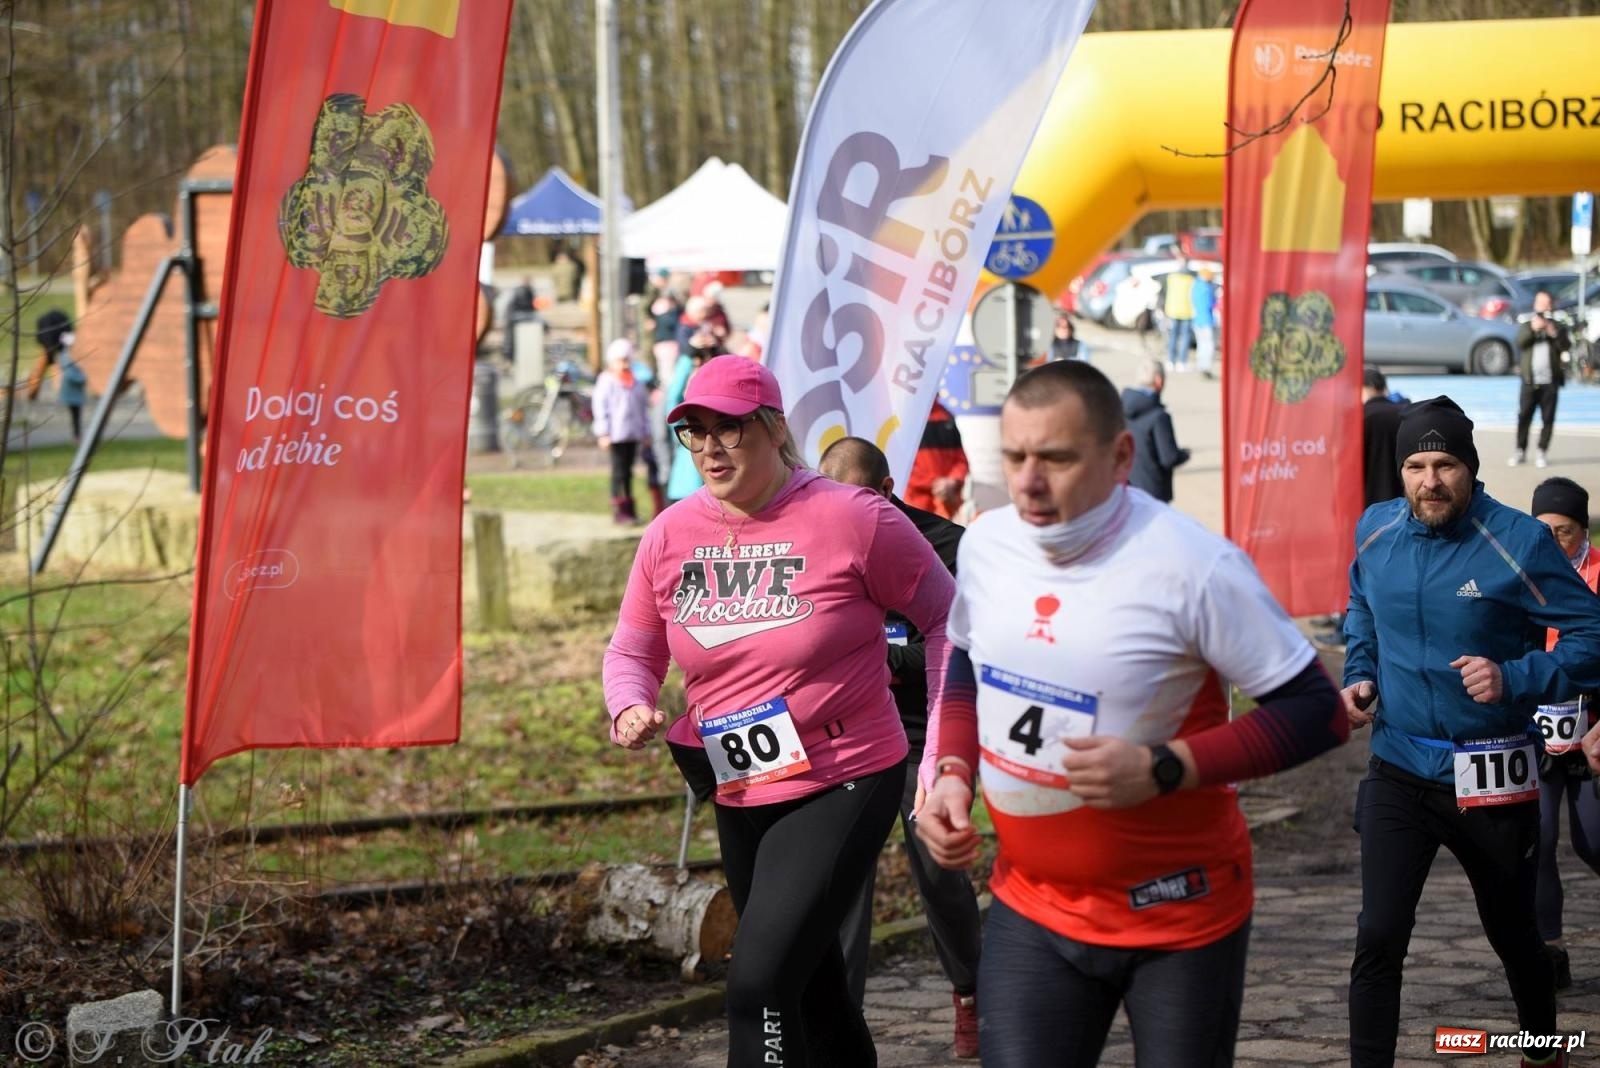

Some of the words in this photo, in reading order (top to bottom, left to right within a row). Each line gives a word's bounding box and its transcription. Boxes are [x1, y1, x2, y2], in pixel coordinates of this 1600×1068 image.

[892, 167, 994, 395] RACIBÓRZ
[334, 390, 399, 423] coś
[273, 432, 343, 466] iebie
[1292, 433, 1327, 456] coś
[694, 545, 733, 560] SIŁA
[737, 541, 794, 559] KREW
[674, 555, 807, 601] AWF
[1456, 590, 1482, 598] adidas
[671, 583, 806, 625] Wrocław
[726, 702, 774, 723] TWARDZIELA
[1008, 704, 1045, 756] 4
[1537, 715, 1577, 740] 60
[720, 723, 780, 771] 80
[1470, 749, 1529, 790] 110
[764, 1007, 783, 1068] PART
